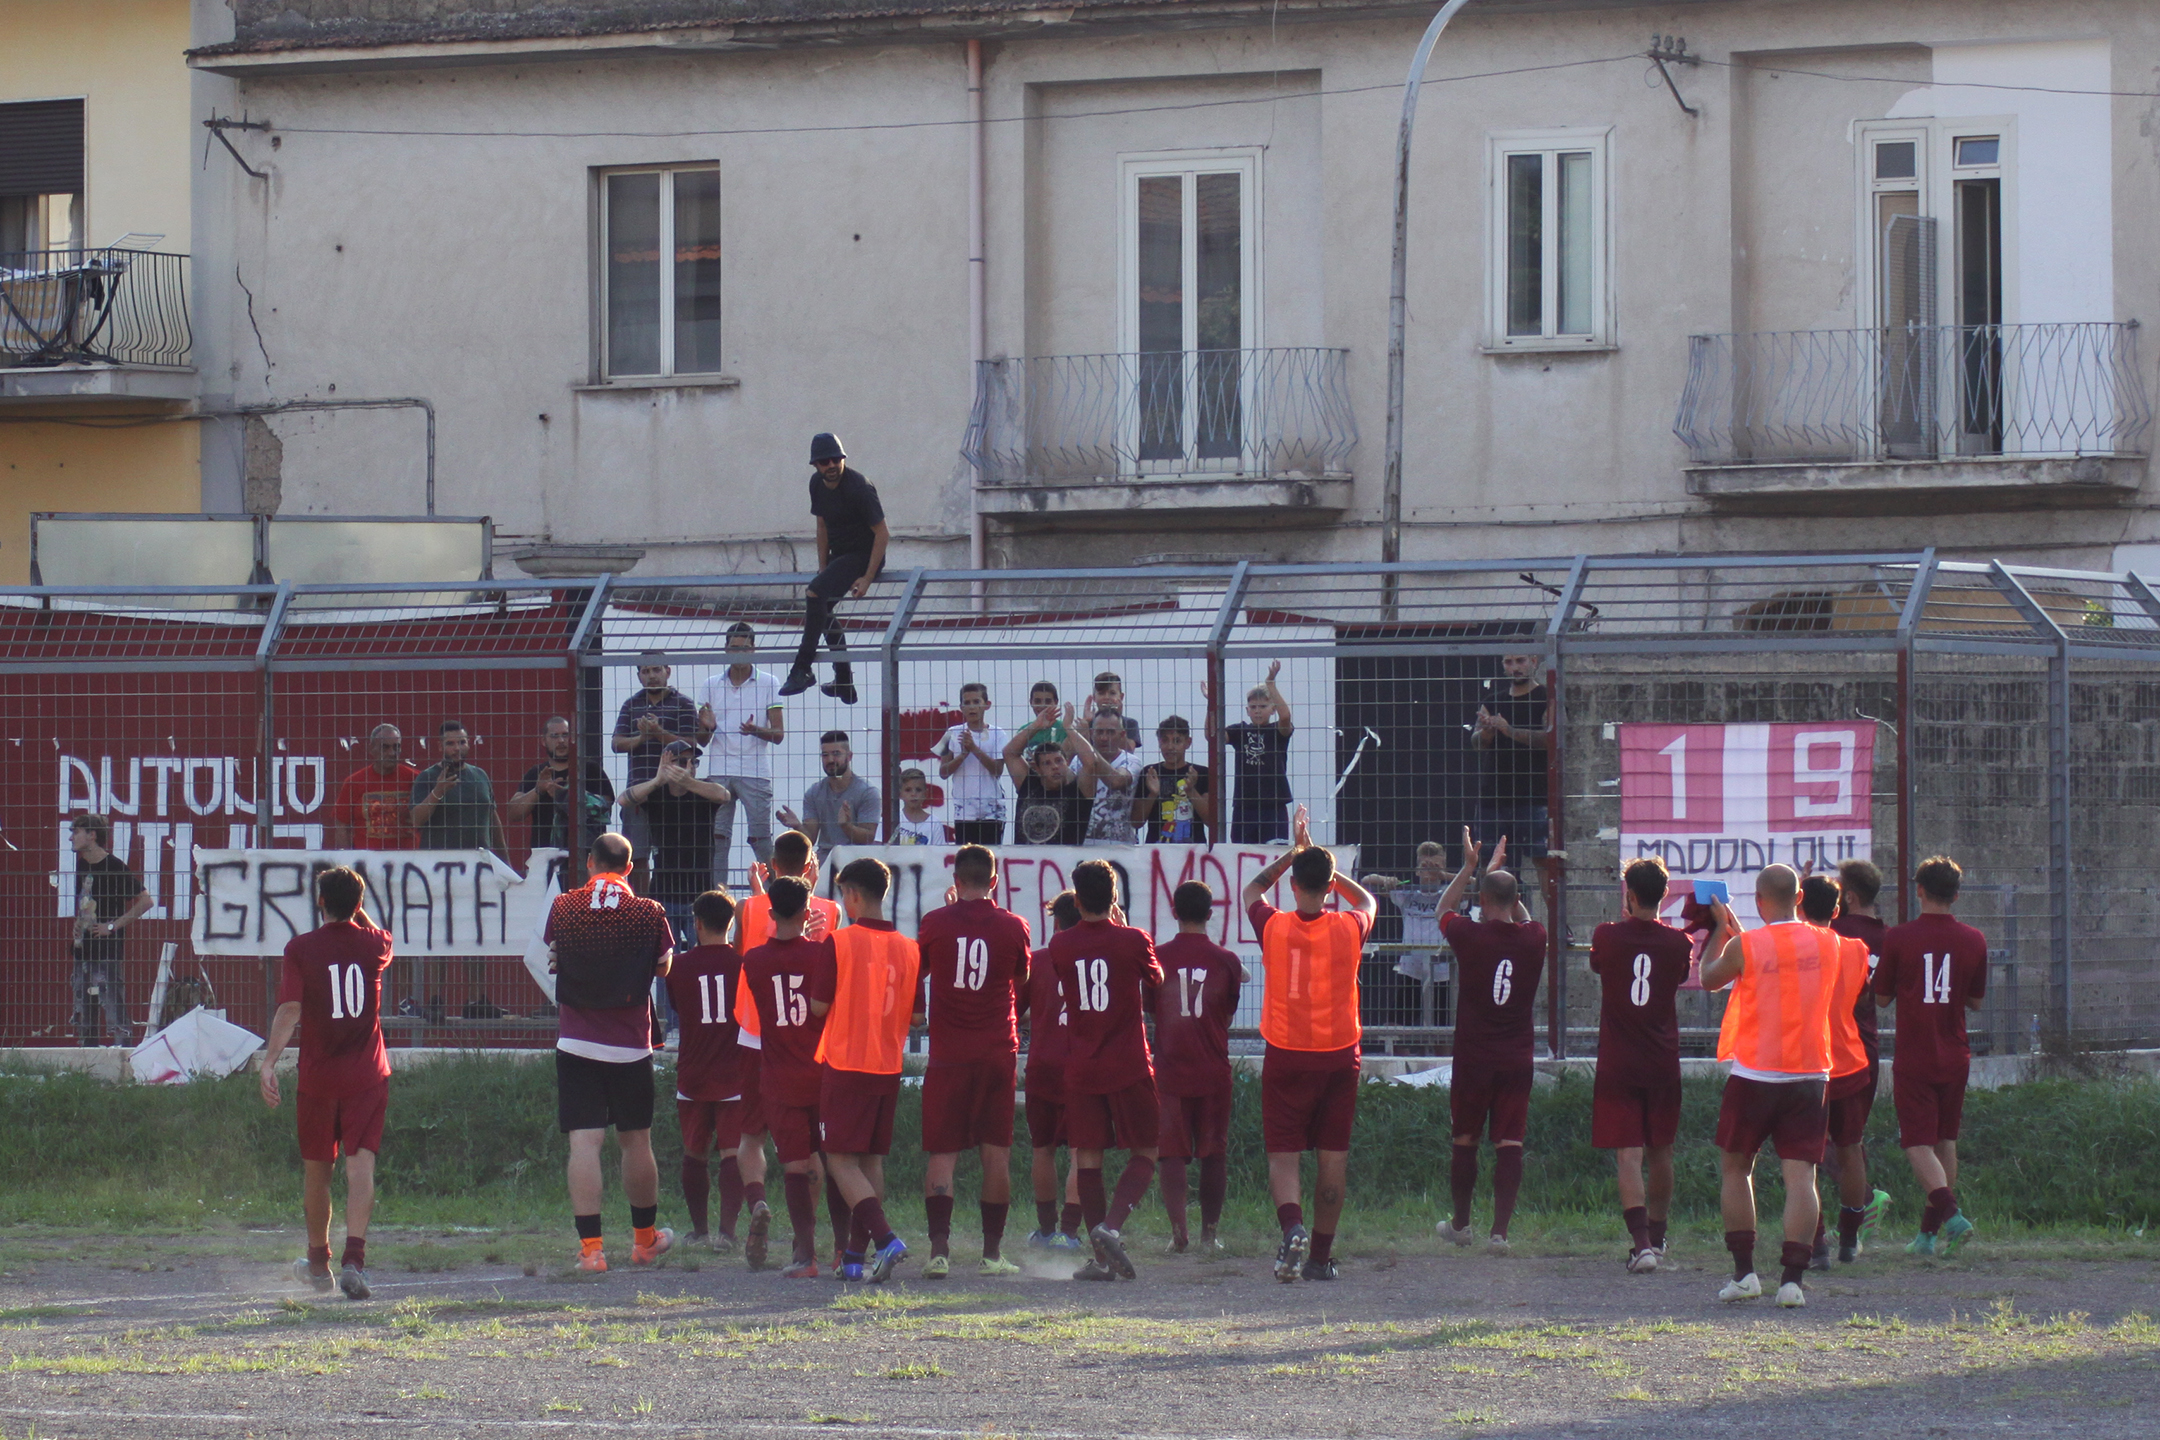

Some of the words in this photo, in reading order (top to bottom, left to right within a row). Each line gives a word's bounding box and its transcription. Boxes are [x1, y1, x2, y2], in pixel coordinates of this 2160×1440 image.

[203, 860, 506, 950] GRNATA
[953, 937, 988, 991] 19
[1074, 958, 1109, 1012] 18
[1493, 959, 1513, 1006] 6
[1630, 953, 1651, 1007] 8
[1923, 953, 1952, 1004] 14
[328, 963, 365, 1019] 10
[698, 974, 728, 1024] 11
[771, 974, 808, 1027] 15
[1177, 967, 1209, 1018] 17
